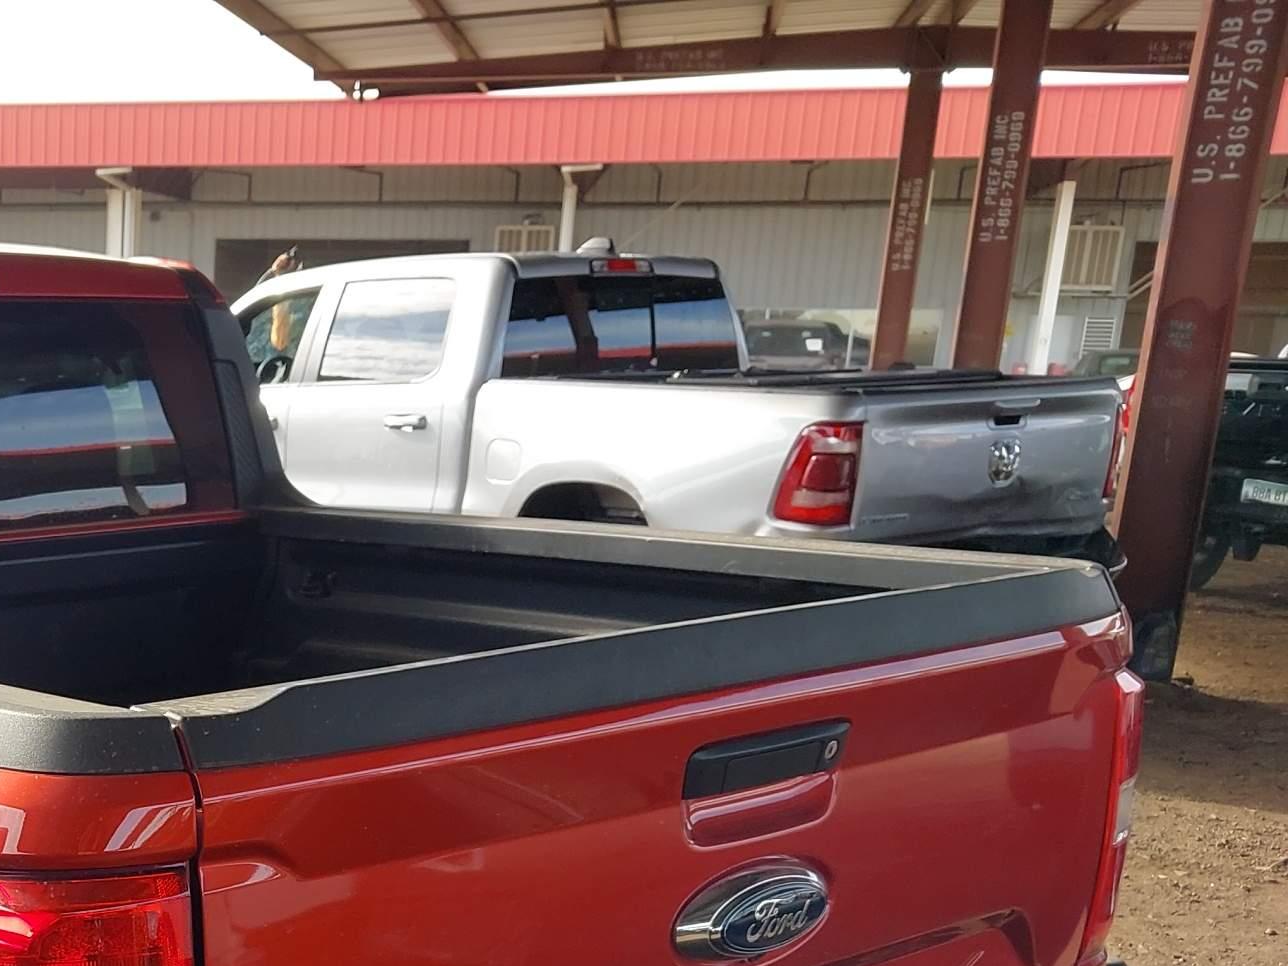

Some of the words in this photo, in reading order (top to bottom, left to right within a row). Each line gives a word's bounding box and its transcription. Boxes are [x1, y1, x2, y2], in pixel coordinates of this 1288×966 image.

[1204, 16, 1244, 119] PREFAB
[1219, 0, 1276, 180] 1-866-799-0
[983, 147, 1004, 206] PREFAB
[1191, 136, 1220, 183] U.S.
[746, 892, 816, 944] Ford
